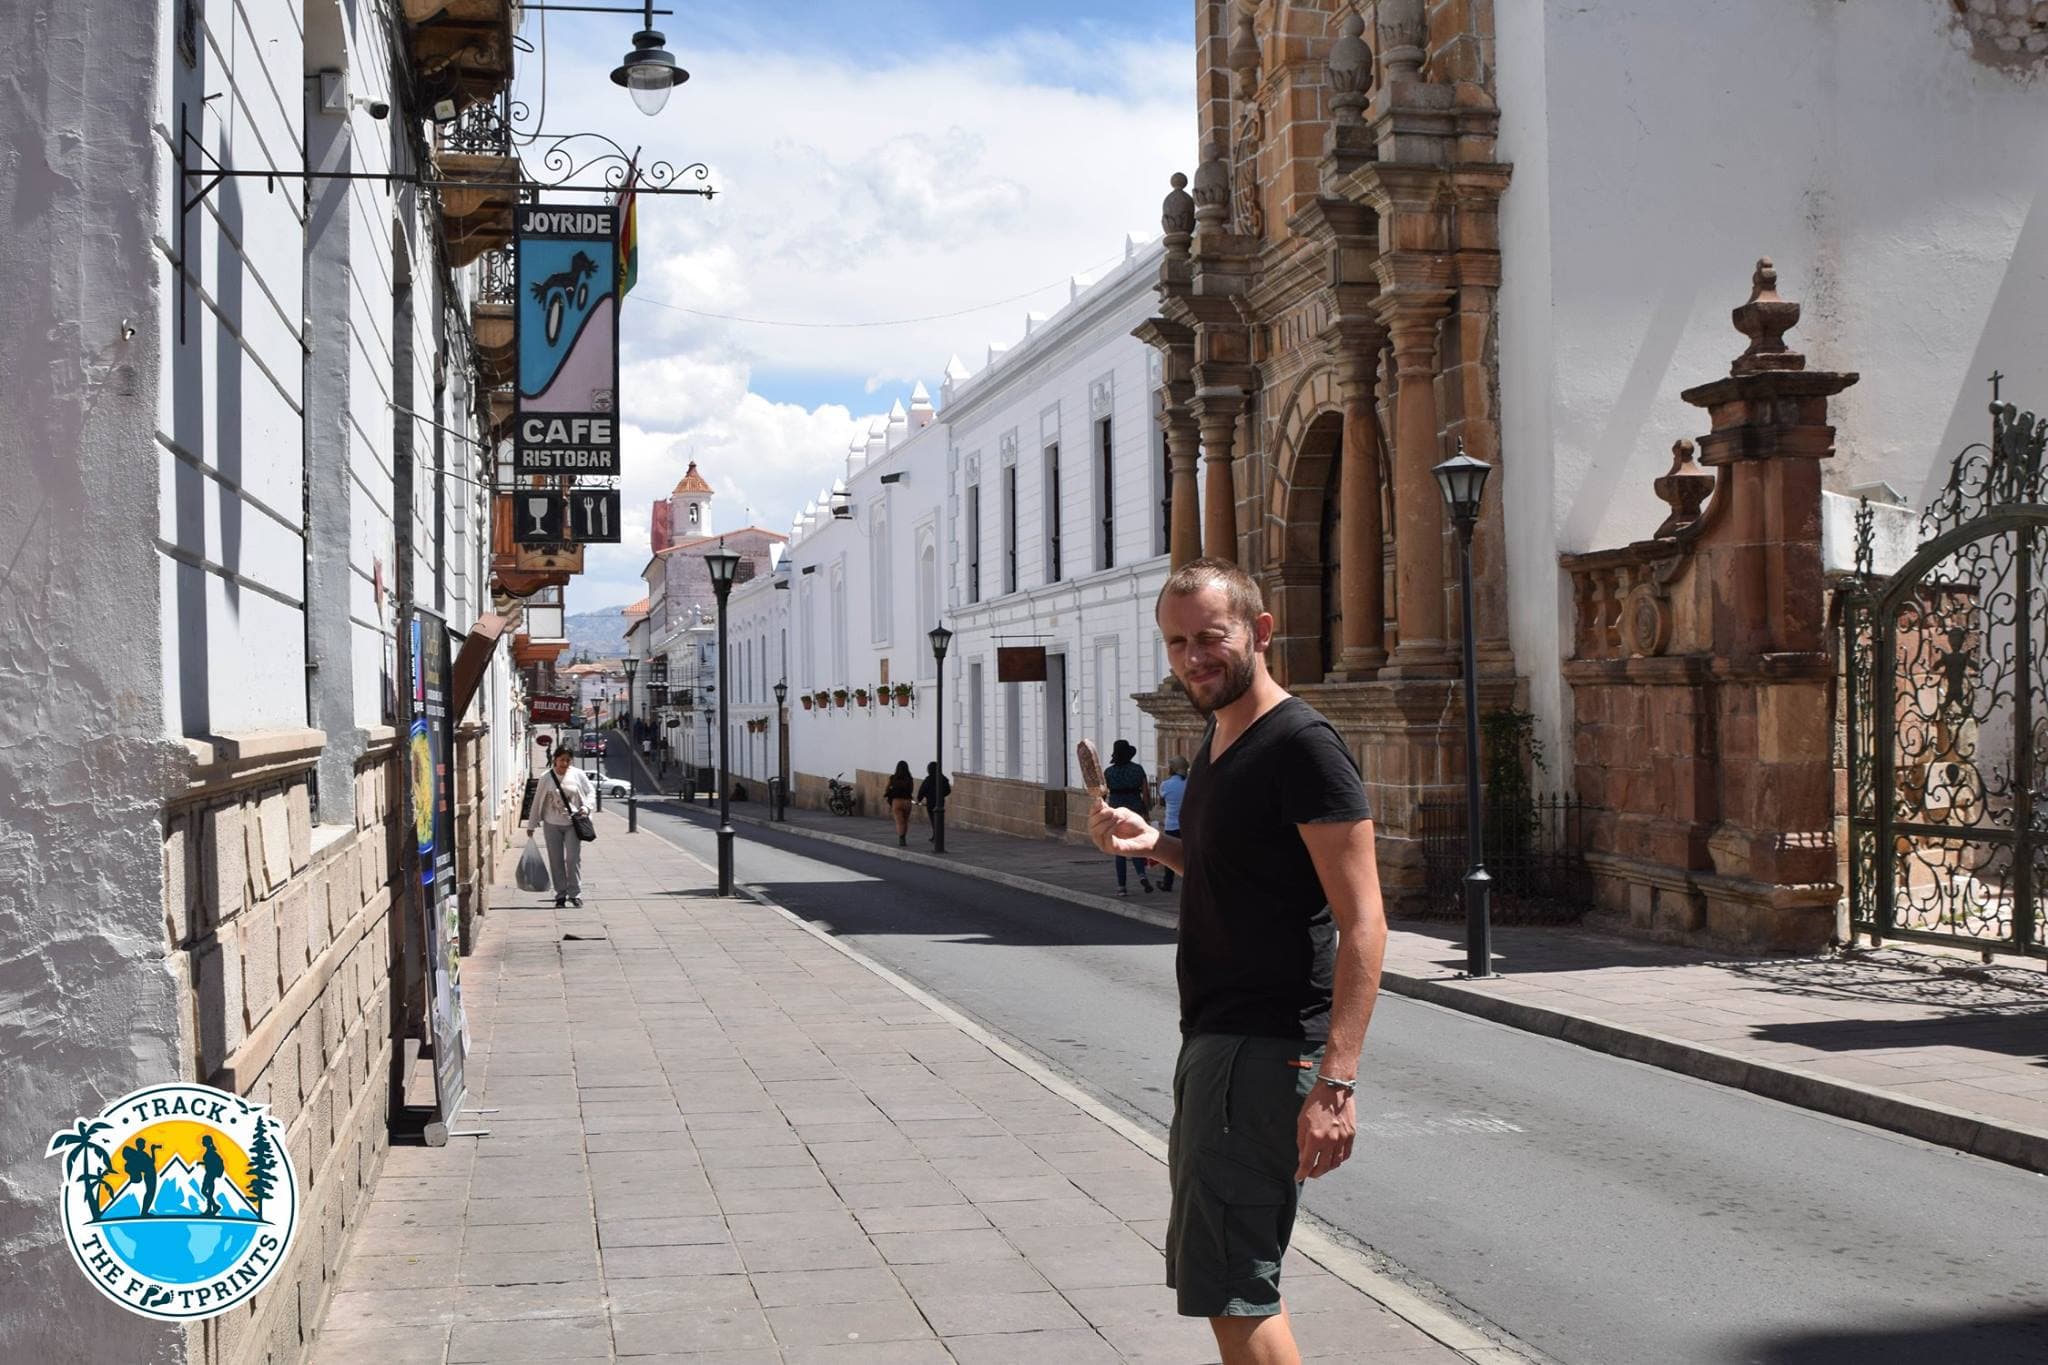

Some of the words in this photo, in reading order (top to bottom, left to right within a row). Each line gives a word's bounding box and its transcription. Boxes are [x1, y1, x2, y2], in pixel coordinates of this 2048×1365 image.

[522, 211, 611, 234] JOYRIDE
[522, 419, 611, 444] CAFE
[522, 449, 611, 467] RISTOBAR
